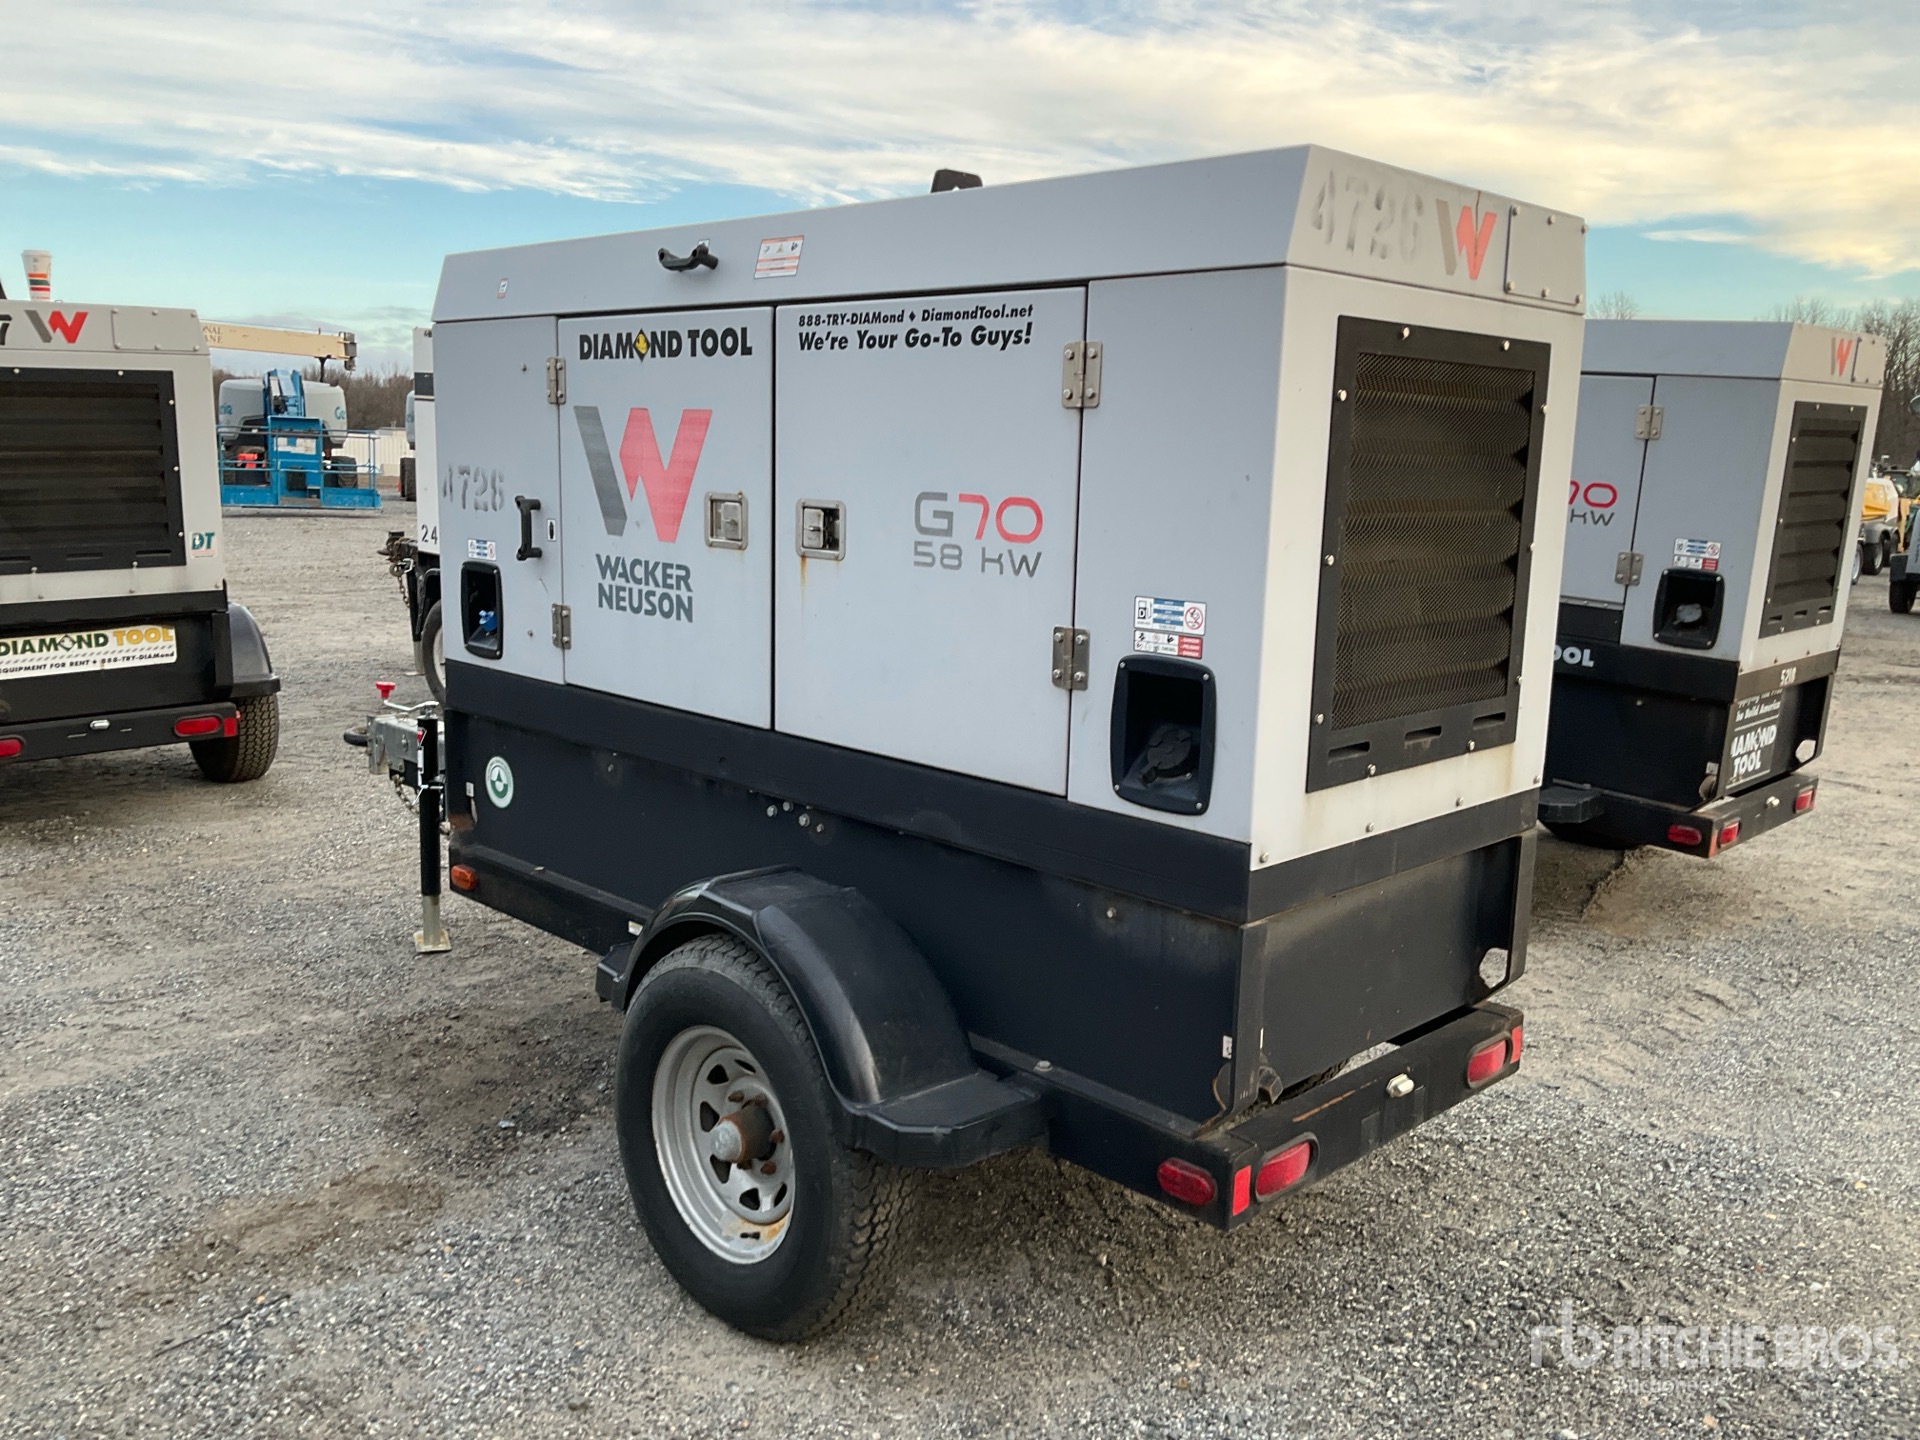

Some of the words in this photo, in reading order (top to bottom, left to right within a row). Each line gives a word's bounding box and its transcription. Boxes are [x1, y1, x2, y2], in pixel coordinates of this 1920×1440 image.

[798, 310, 904, 328] 888-TRY-DIAMond
[921, 304, 1033, 323] DiamondTool.net
[687, 327, 753, 357] TOOL
[798, 331, 849, 351] We're
[856, 329, 898, 349] Your
[905, 327, 962, 348] Go-To
[970, 322, 1033, 351] Guys!
[914, 491, 1043, 544] G70
[191, 531, 215, 550] DT
[913, 541, 963, 571] 58
[595, 553, 693, 593] WACKER
[597, 582, 693, 623] NEUSON
[113, 626, 174, 647] TOOL
[69, 659, 90, 667] RENT
[1730, 725, 1777, 757] IAMOND
[1733, 749, 1762, 778] TOOL
